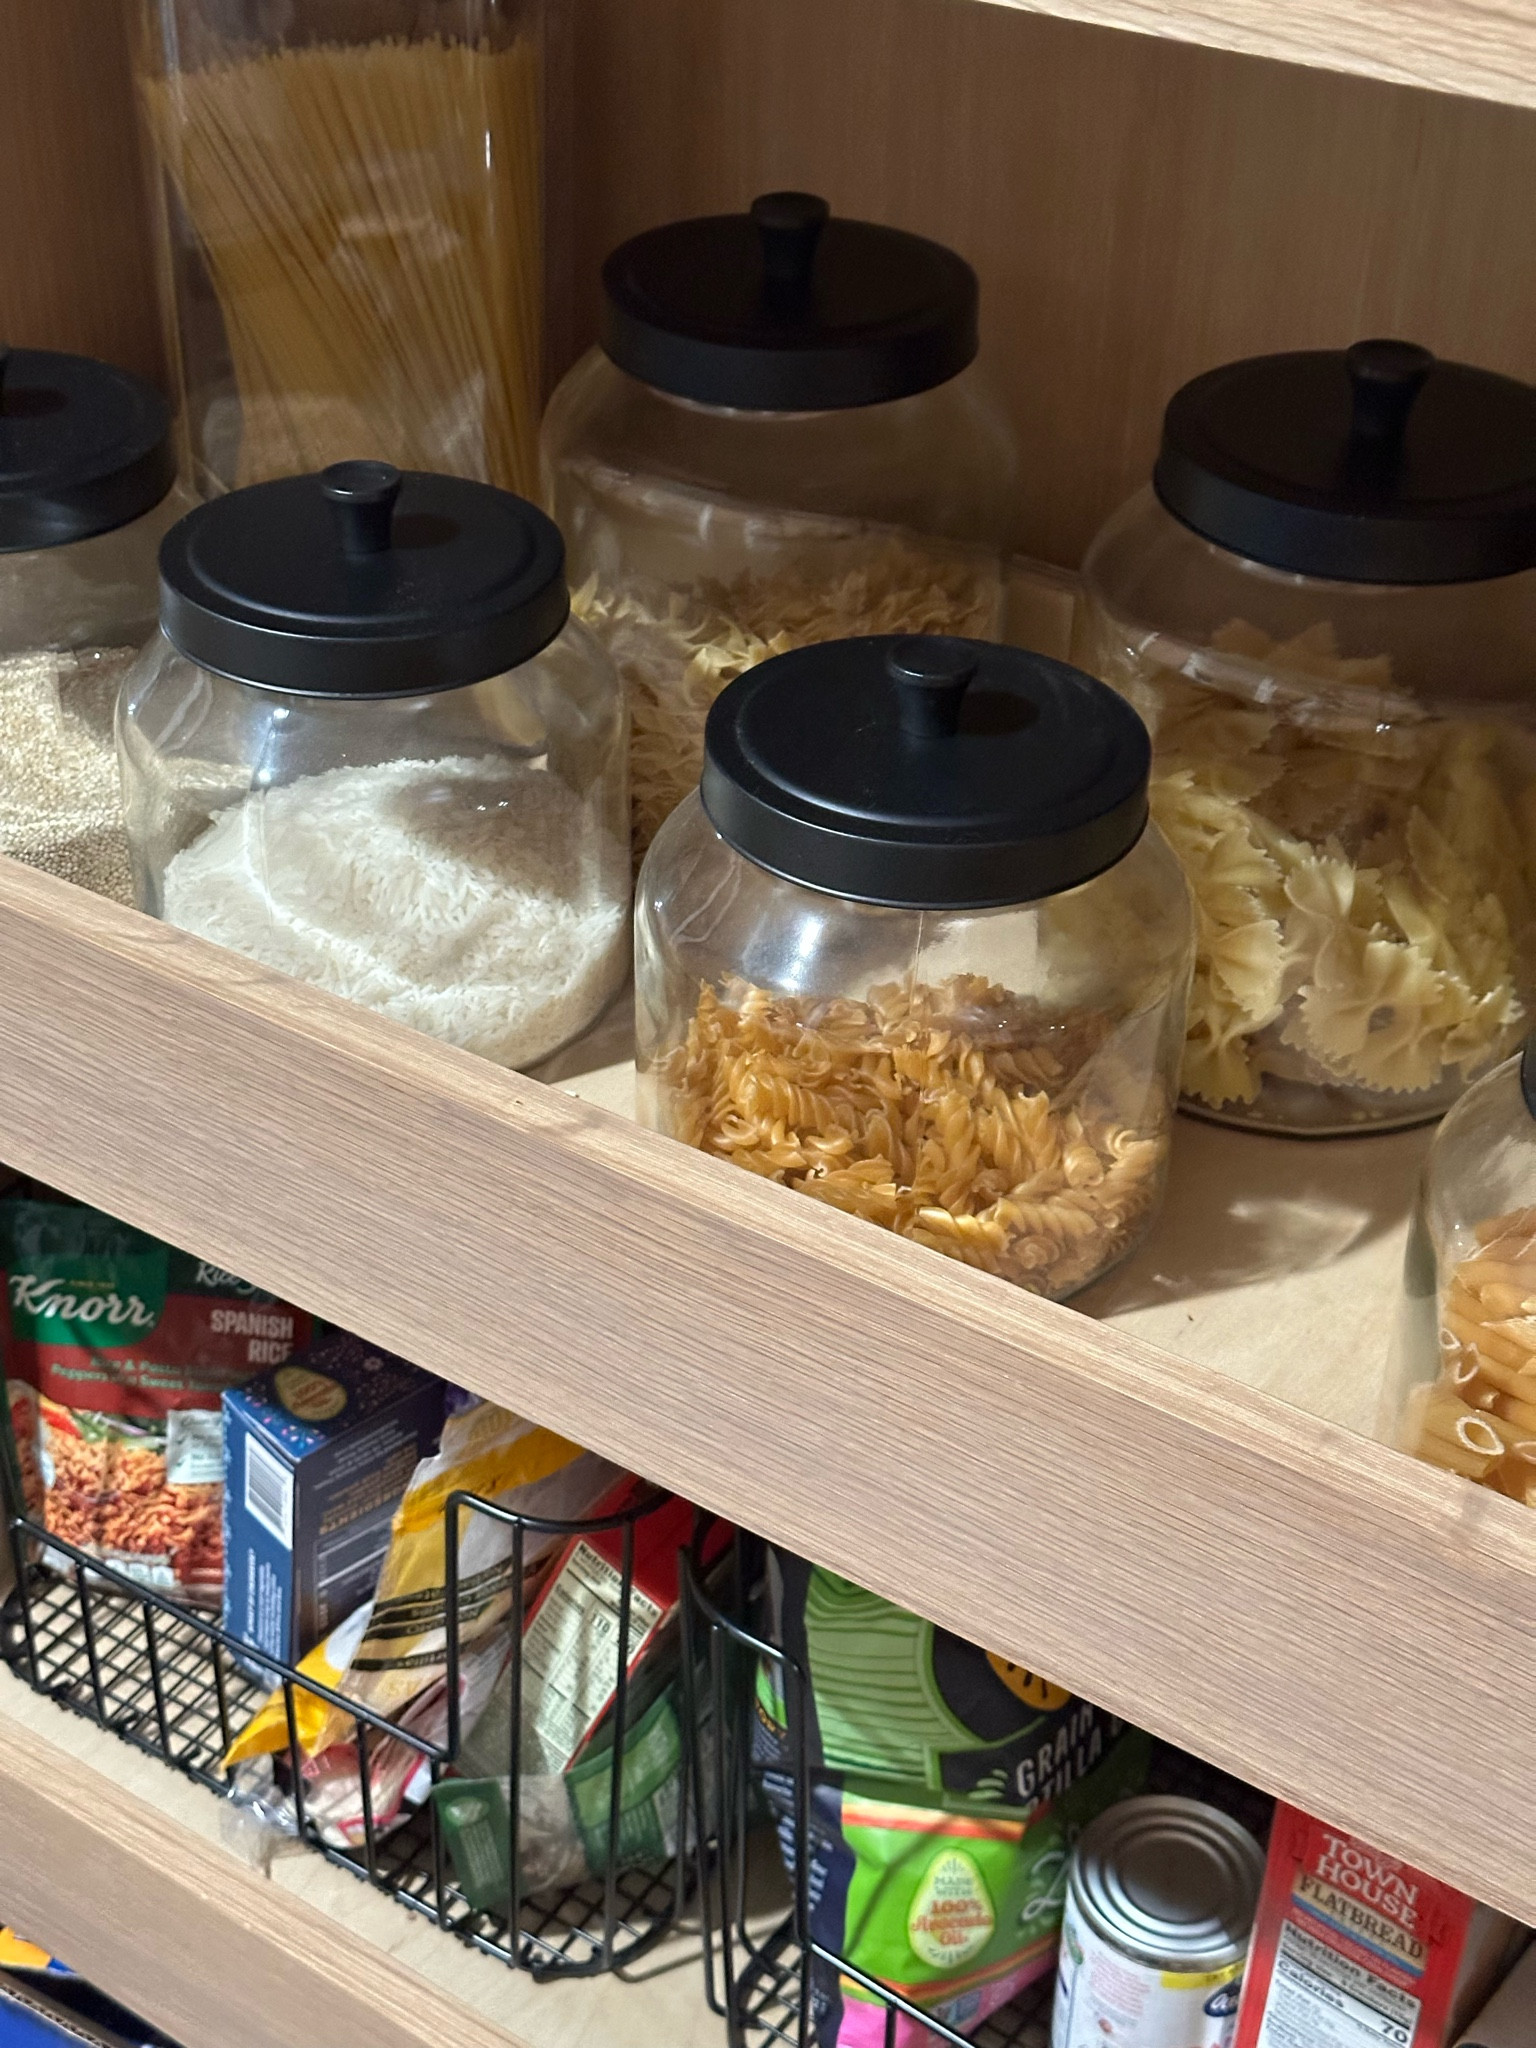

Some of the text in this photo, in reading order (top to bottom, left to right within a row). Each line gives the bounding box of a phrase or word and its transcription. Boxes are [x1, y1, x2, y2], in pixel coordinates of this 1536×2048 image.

[10, 1274, 154, 1327] Knorr
[210, 1308, 294, 1339] SPANISH
[579, 1543, 623, 1587] Nutritio
[1016, 1703, 1094, 1798] GRAIN
[1316, 1855, 1418, 1929] HOUSE
[1323, 1833, 1419, 1905] TOWN
[1300, 1873, 1424, 1960] FLATBREAD
[1278, 1960, 1344, 2008] Calories
[1380, 2020, 1408, 2043] 70
[1285, 1923, 1361, 1977] Nutrition
[1367, 1975, 1416, 2008] Facts
